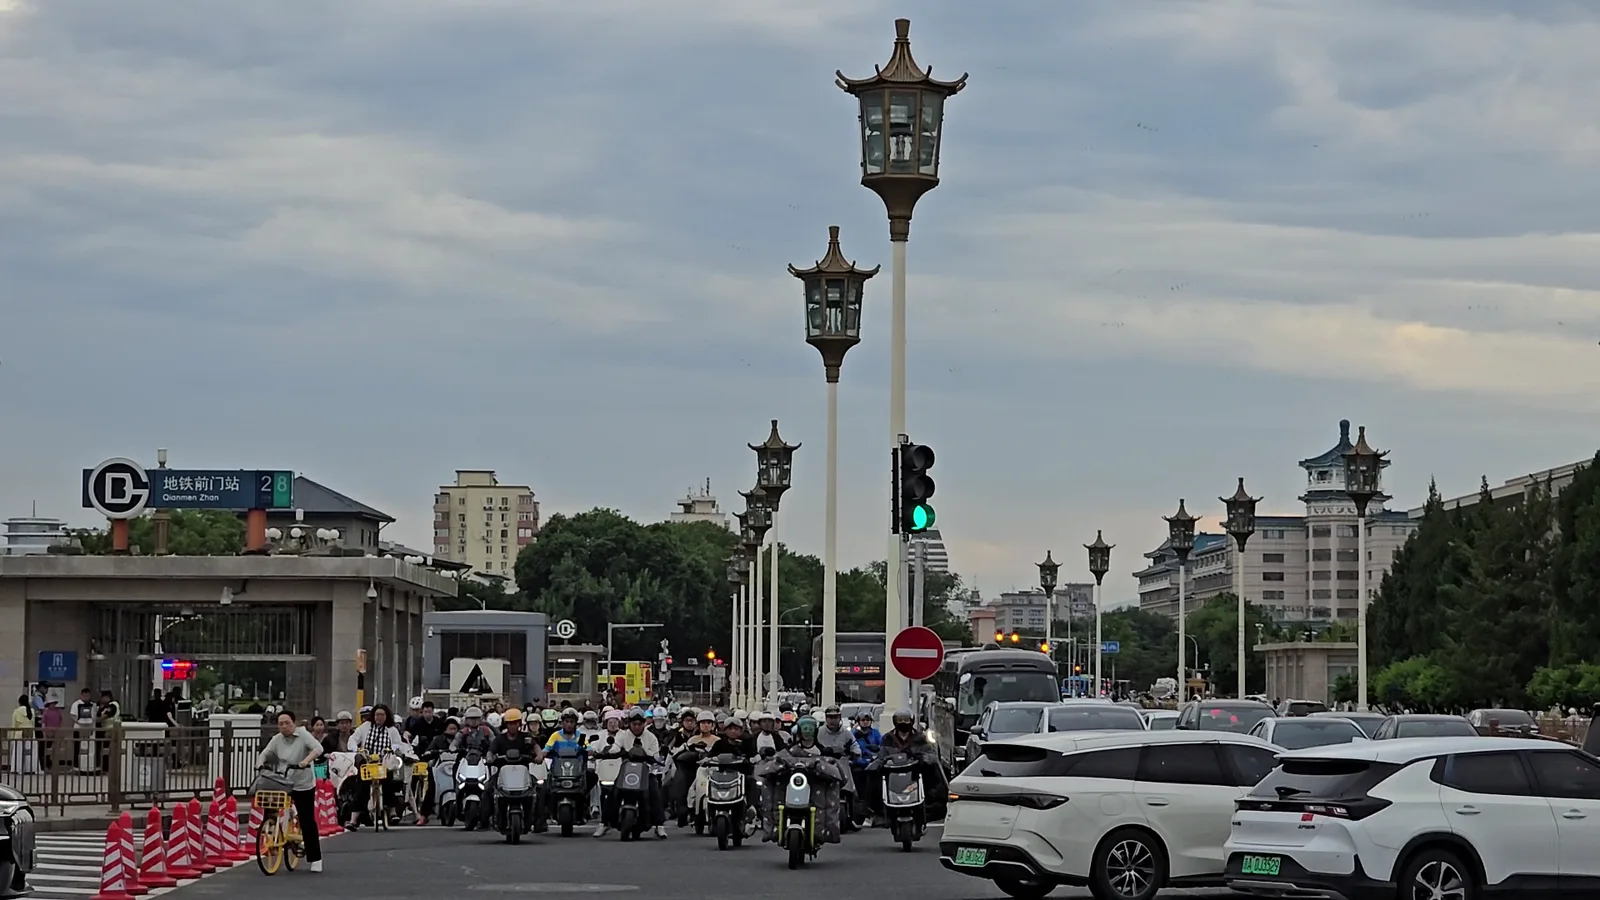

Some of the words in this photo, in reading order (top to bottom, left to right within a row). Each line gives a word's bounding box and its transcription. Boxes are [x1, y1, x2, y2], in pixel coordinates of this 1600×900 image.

[163, 476, 240, 491] 地铁前门站
[260, 475, 272, 491] 2
[277, 475, 288, 491] 8
